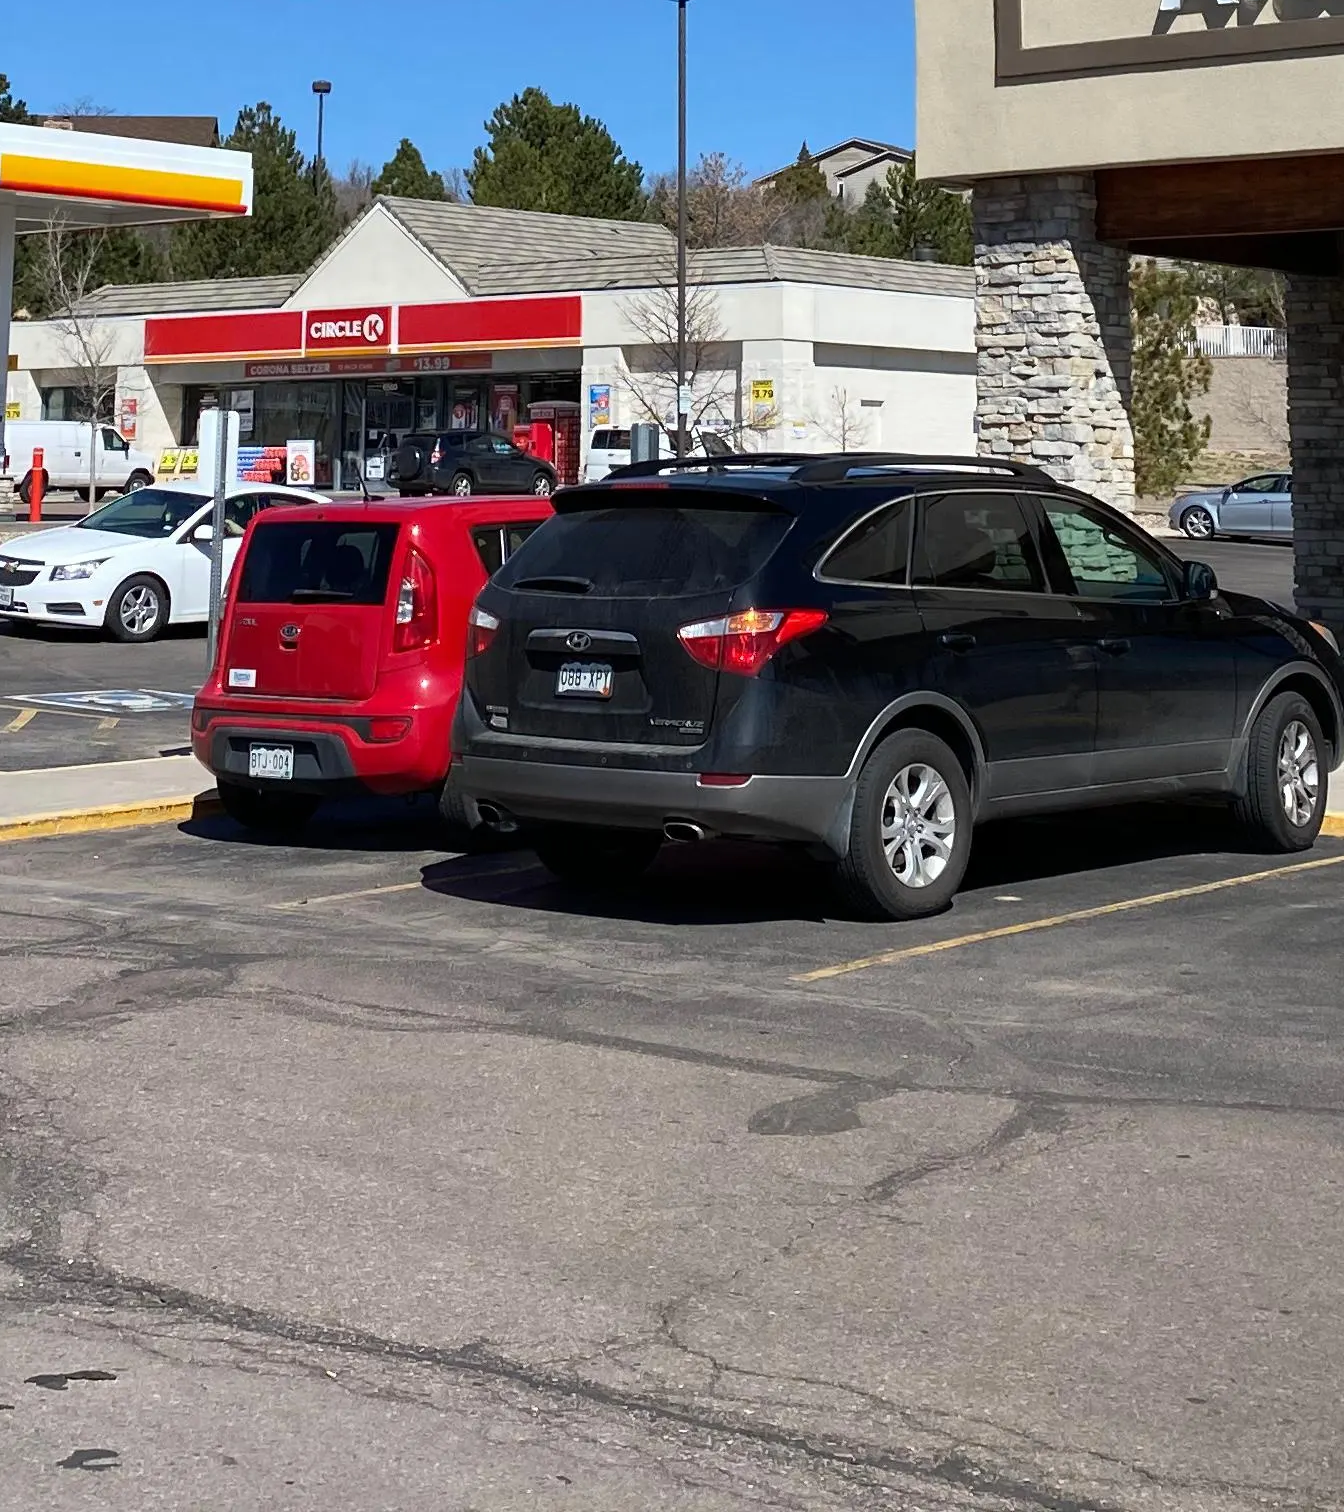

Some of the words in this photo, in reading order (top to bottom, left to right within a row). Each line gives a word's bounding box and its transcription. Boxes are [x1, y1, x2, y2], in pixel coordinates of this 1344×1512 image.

[310, 320, 362, 339] CIRCLE
[250, 364, 289, 376] CORONA
[291, 362, 330, 375] SELTZER
